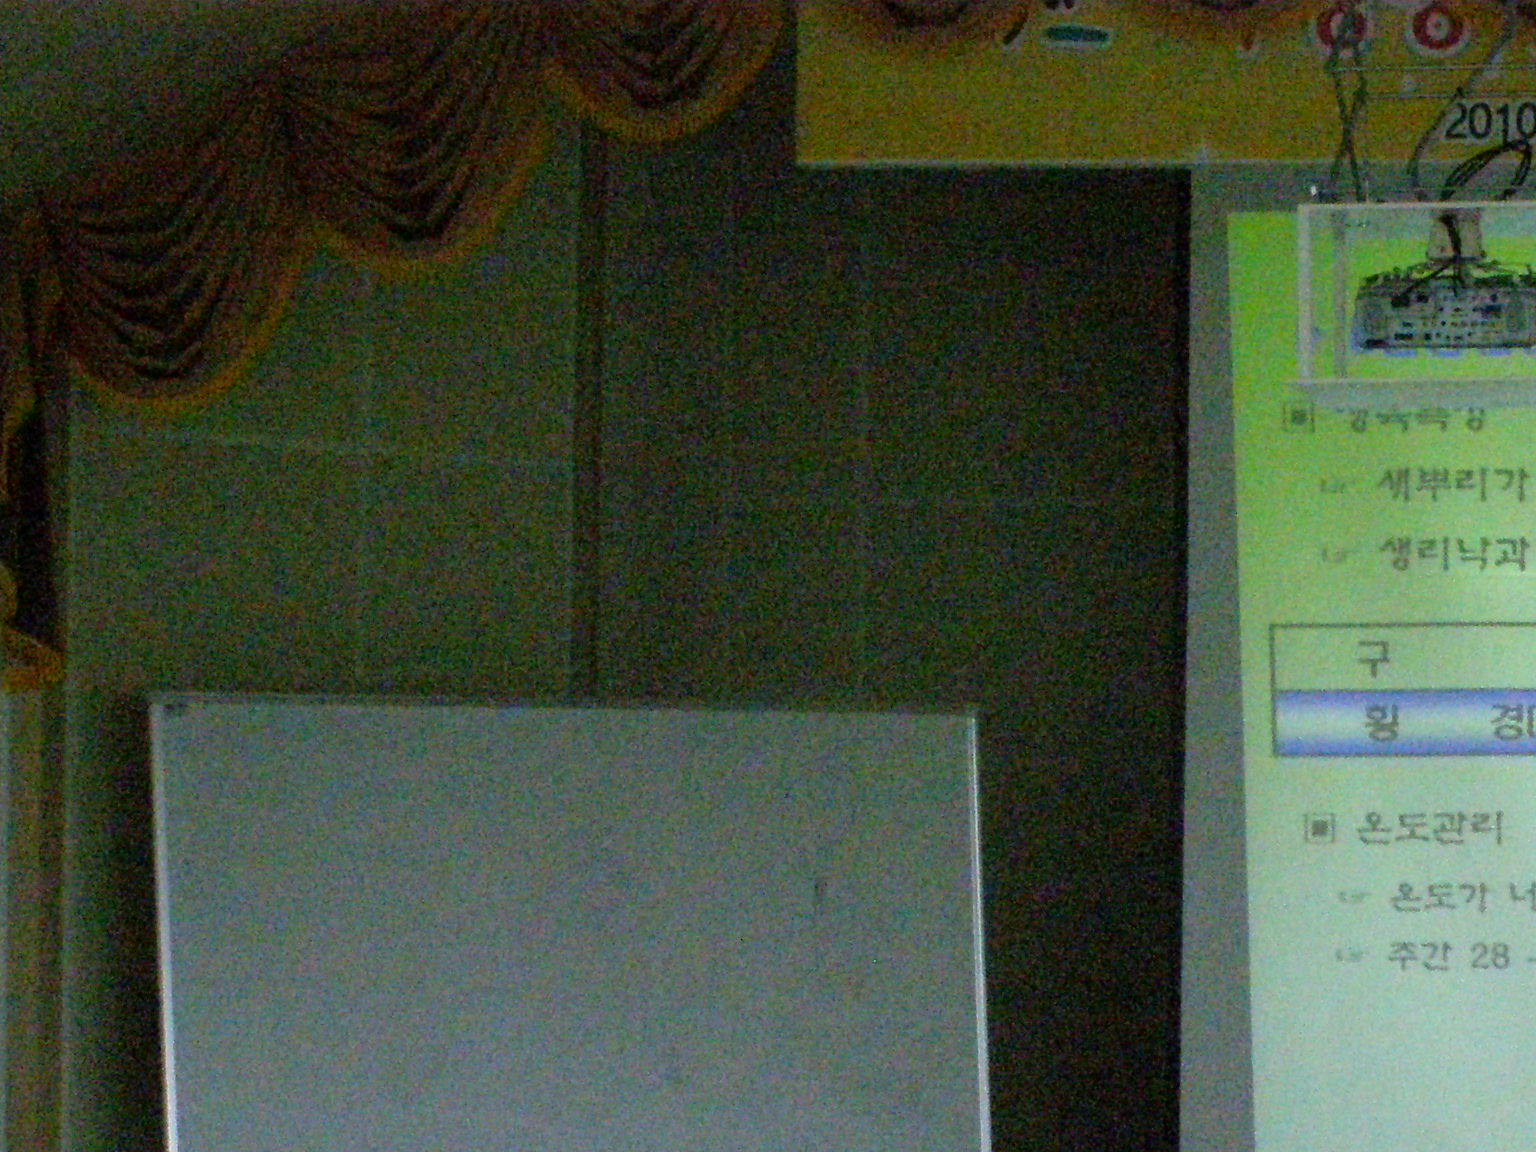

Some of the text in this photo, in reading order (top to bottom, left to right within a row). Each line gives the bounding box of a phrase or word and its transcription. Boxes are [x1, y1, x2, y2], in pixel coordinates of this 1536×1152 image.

[1377, 466, 1530, 502] 새뿌리가
[1378, 535, 1531, 572] 생리낙과
[1358, 640, 1391, 678] 구
[1357, 810, 1504, 845] 온도관리
[1390, 881, 1489, 914] 온도가
[1388, 940, 1452, 972] 주간
[1470, 941, 1511, 970] 28
